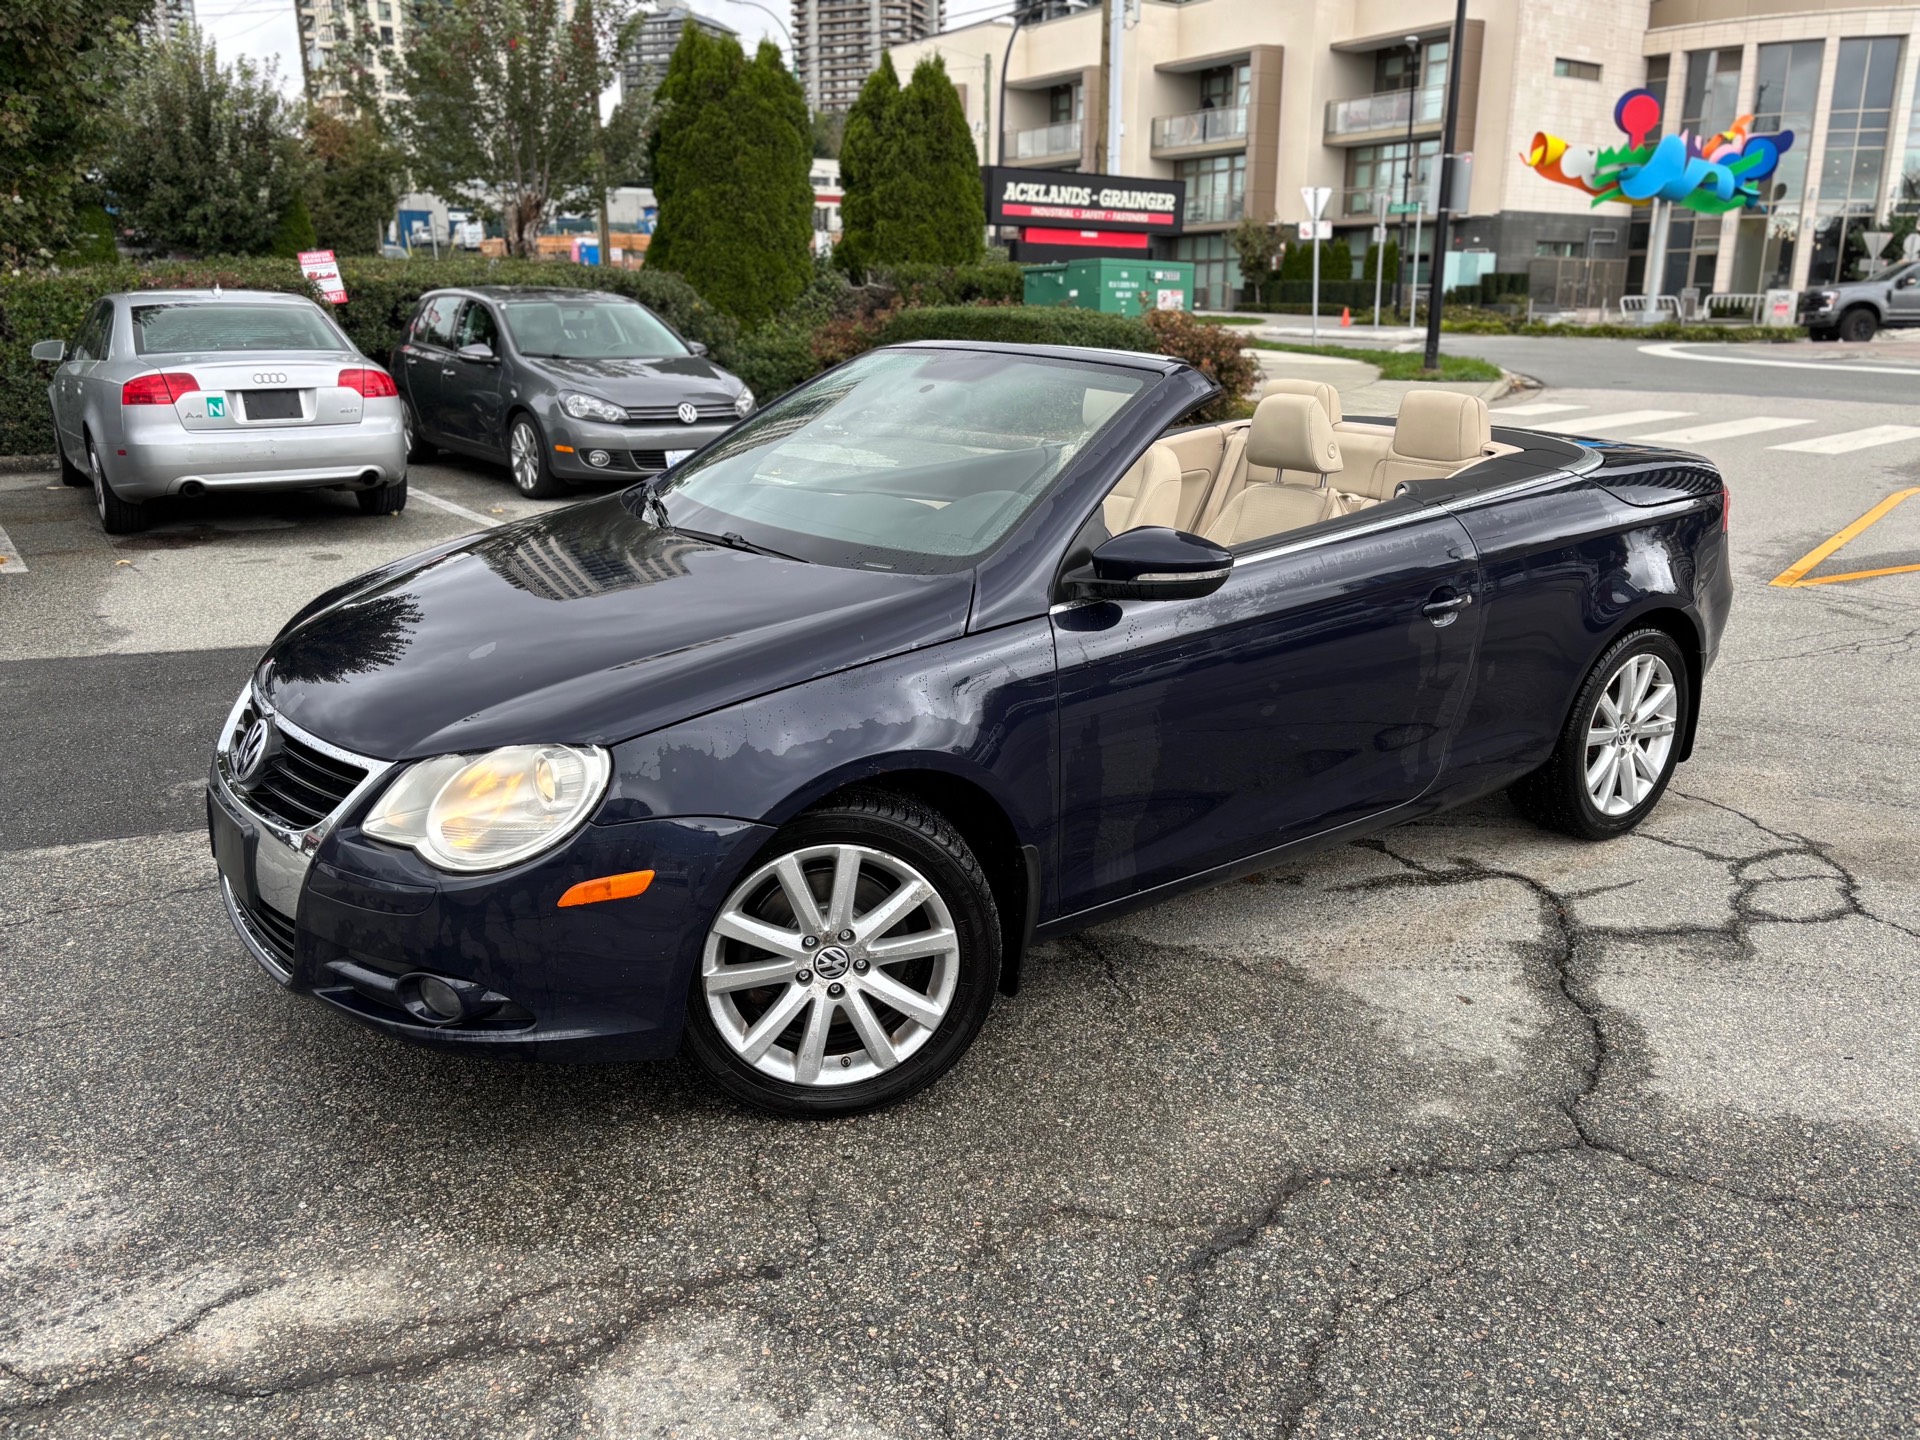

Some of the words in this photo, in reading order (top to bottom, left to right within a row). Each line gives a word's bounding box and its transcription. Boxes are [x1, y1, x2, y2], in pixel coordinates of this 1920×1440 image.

[1031, 207, 1075, 218] INDUSTRIAL
[1081, 210, 1106, 219] SAFETY
[1112, 212, 1149, 222] FASTENERS
[208, 402, 224, 416] N
